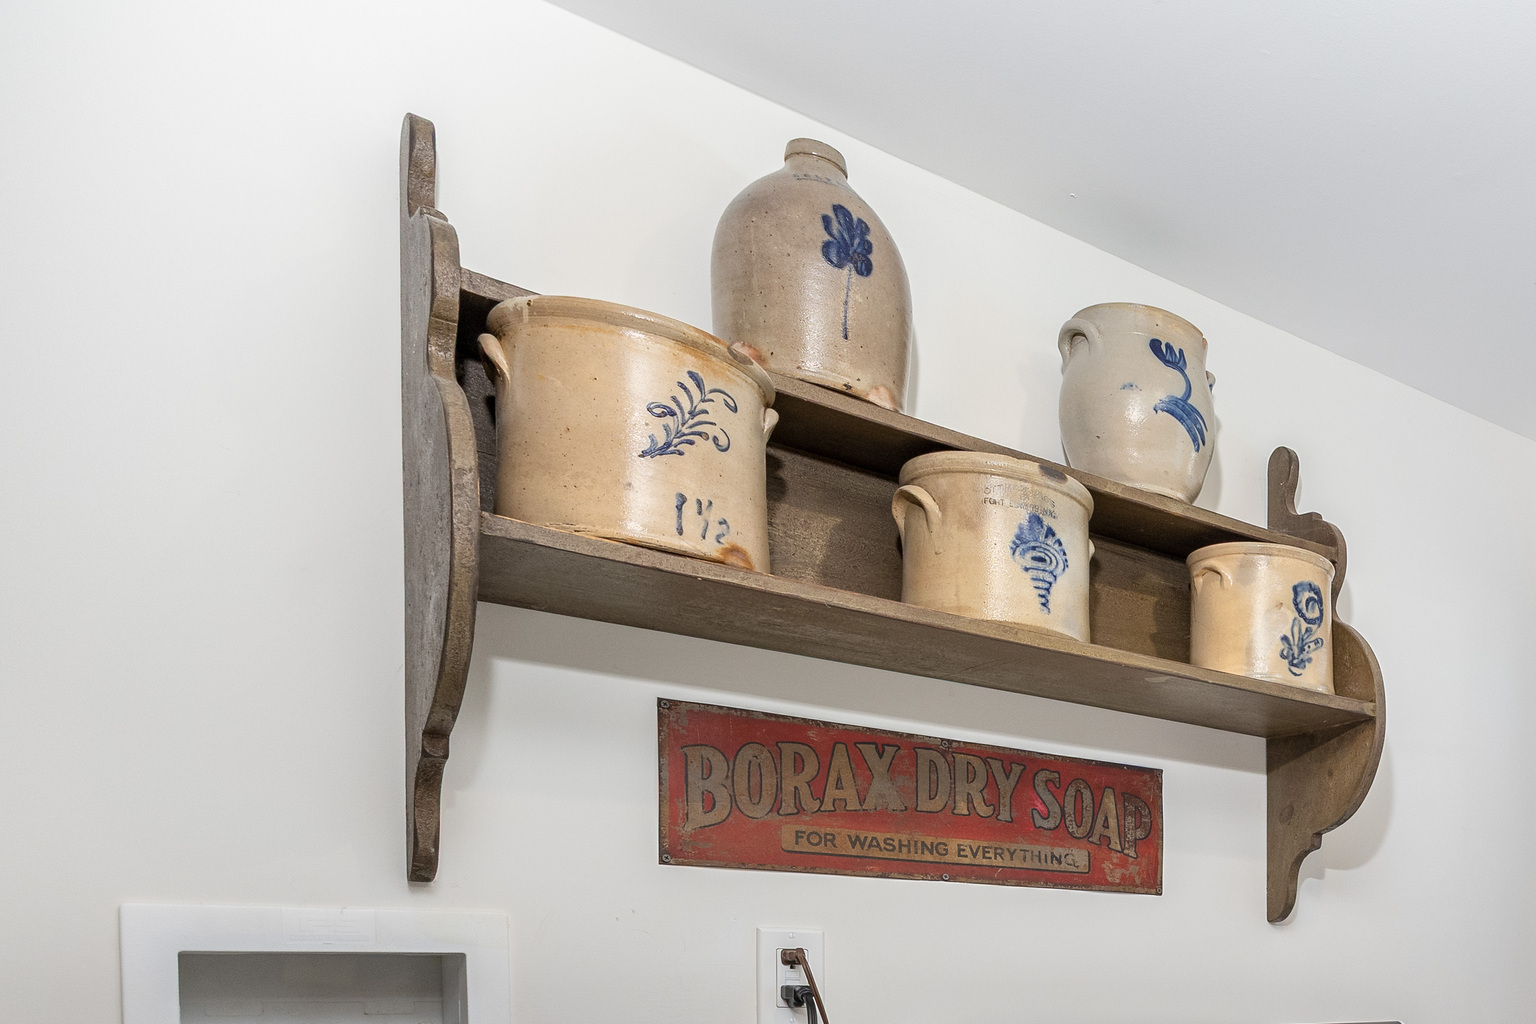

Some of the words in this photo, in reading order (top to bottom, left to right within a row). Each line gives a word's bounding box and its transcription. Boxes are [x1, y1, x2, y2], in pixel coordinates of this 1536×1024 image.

[681, 742, 908, 831] BORAX
[914, 746, 1026, 823] DRY
[1031, 769, 1152, 859] SOAP
[794, 830, 838, 849] FOR
[847, 834, 949, 858] WASHING
